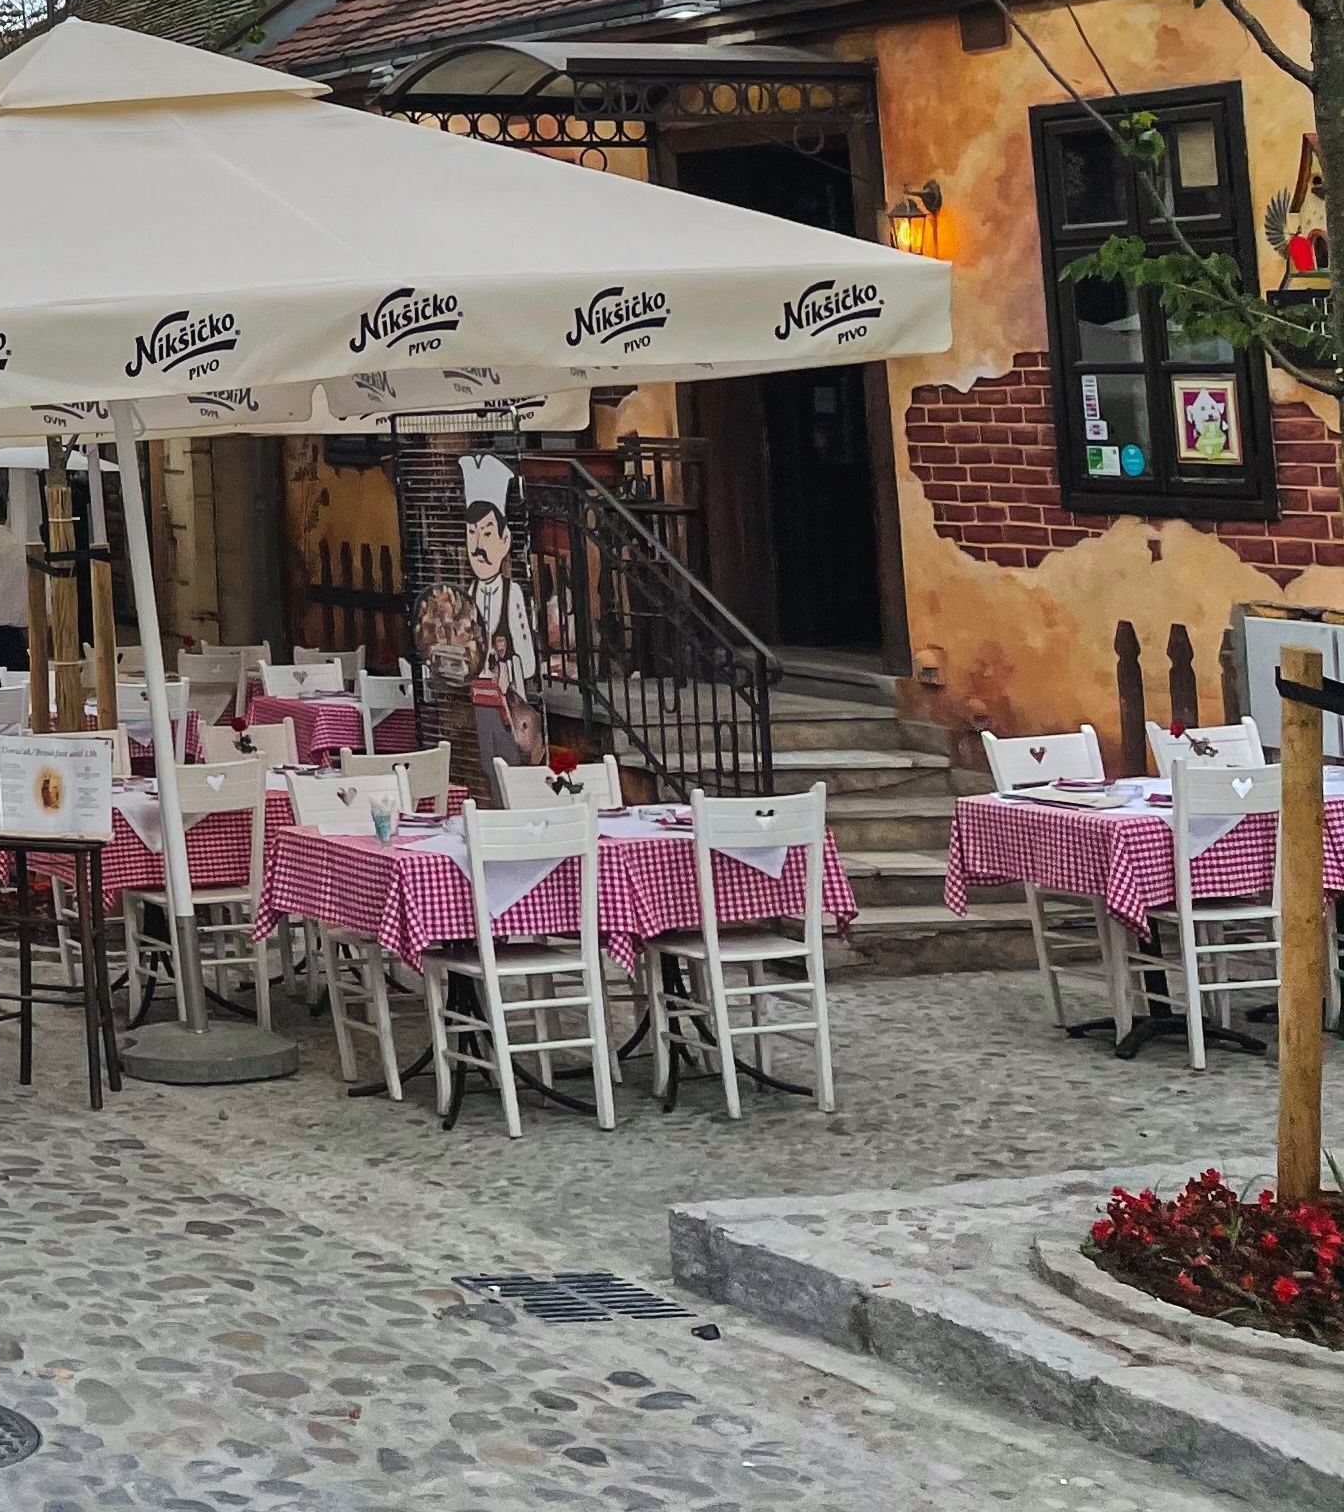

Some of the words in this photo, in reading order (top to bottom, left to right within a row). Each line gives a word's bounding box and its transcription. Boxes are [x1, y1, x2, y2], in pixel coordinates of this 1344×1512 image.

[624, 335, 651, 354] PIVO
[837, 325, 868, 345] PIVO
[408, 338, 442, 356] PIVO
[188, 358, 221, 380] PIVO
